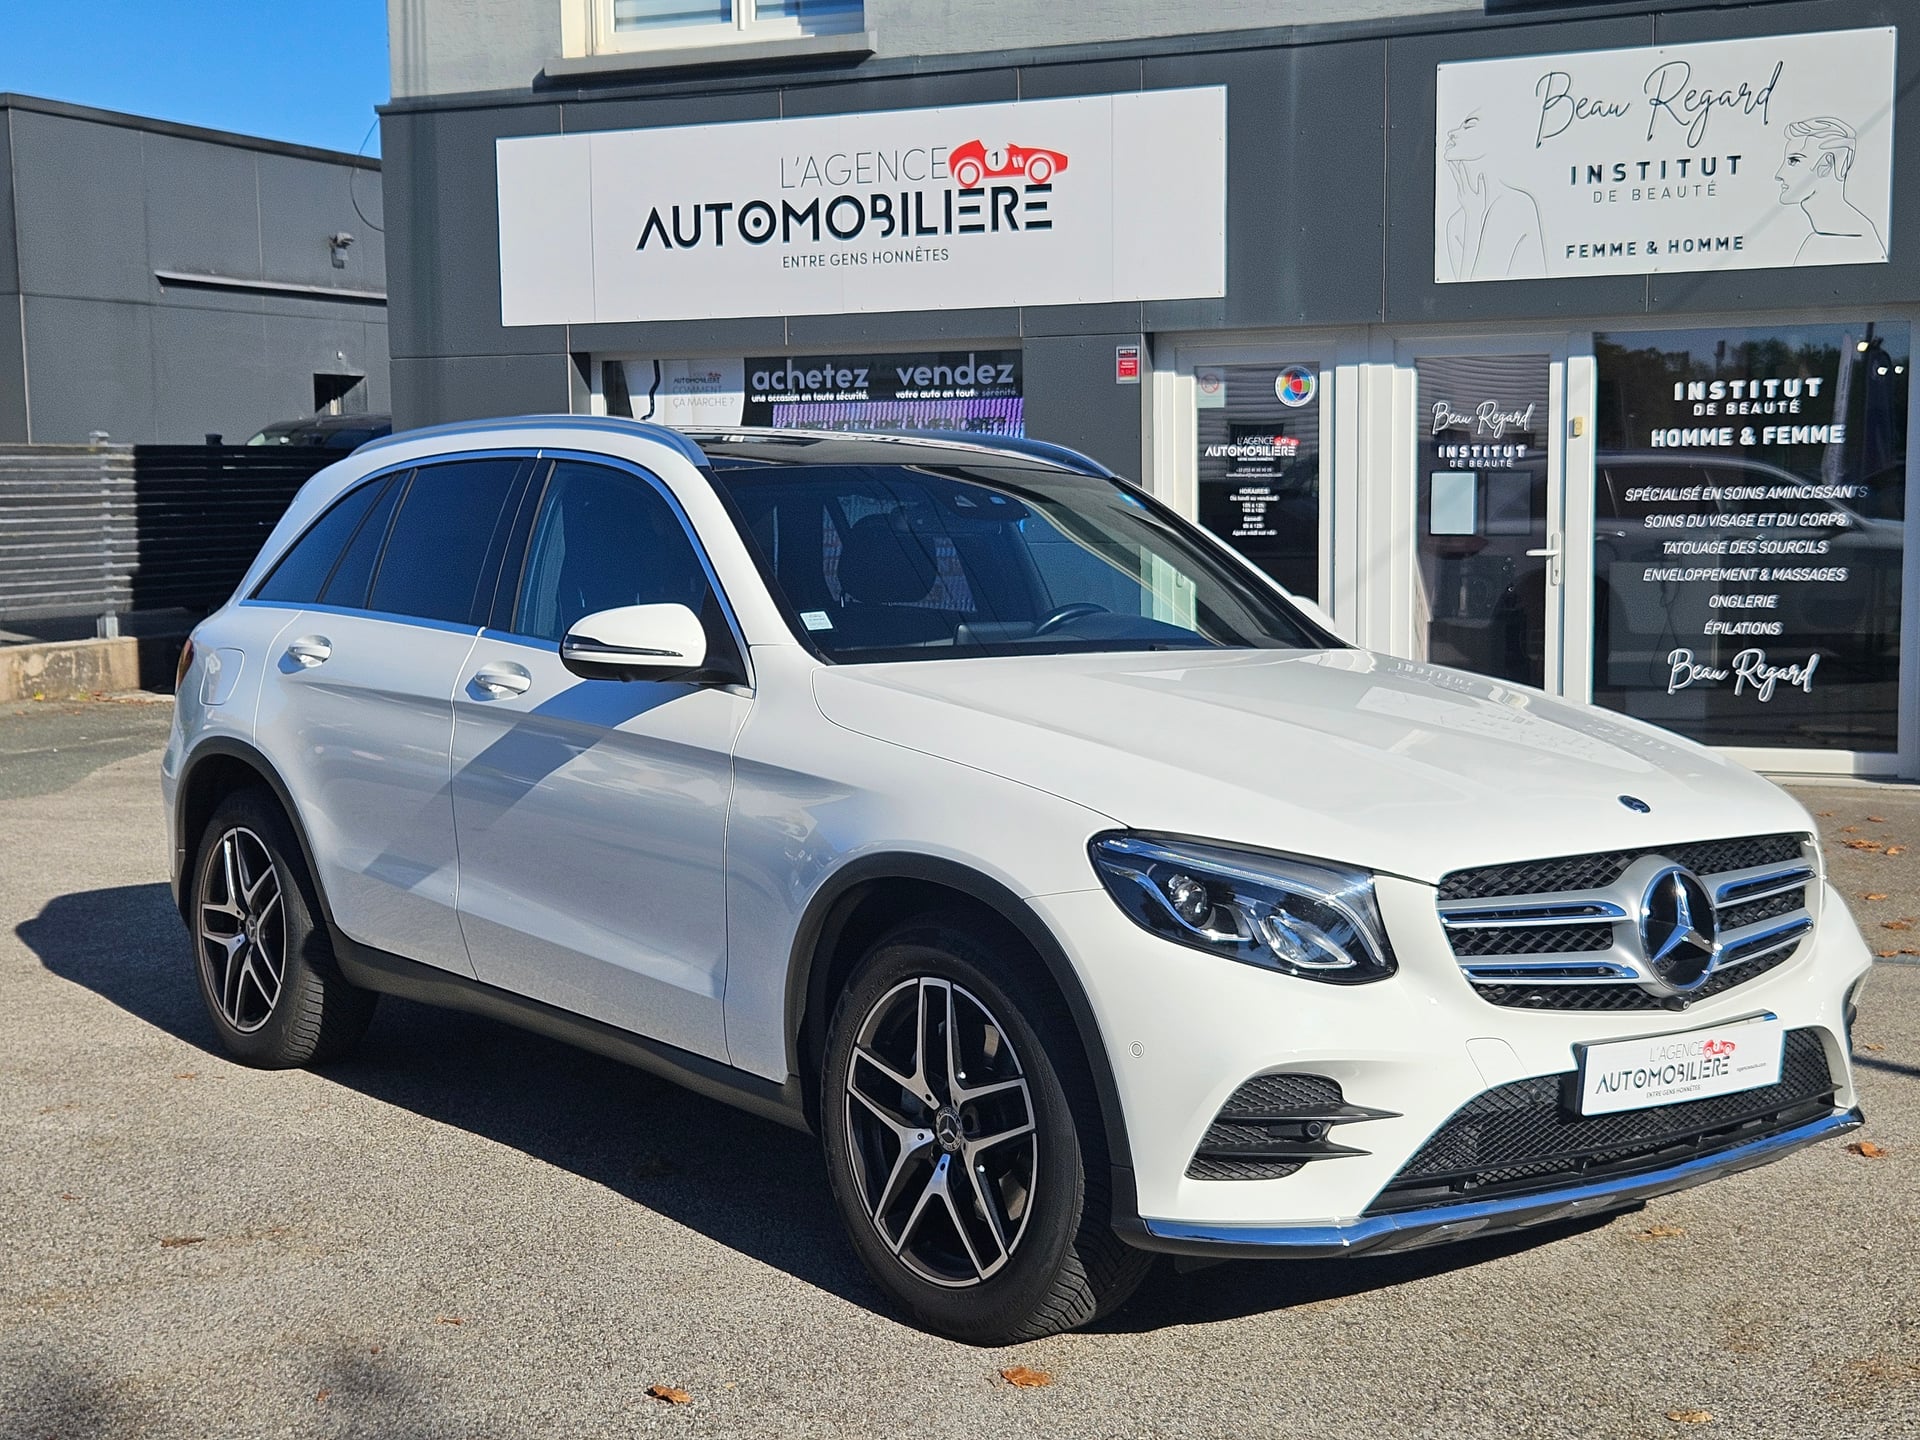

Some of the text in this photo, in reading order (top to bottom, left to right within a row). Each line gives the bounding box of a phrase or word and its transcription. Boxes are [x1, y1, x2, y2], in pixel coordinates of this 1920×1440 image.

[1535, 60, 1784, 148] Beau Regard
[781, 146, 948, 189] L'AGENCE
[1571, 155, 1742, 185] INSTITUT
[1593, 181, 1717, 204] DE BEAUTÉ
[1566, 235, 1744, 259] FEMME & HOMME
[783, 246, 949, 269] ENTRE GENS HONNÊTES
[751, 353, 1015, 390] achetez vendez
[751, 389, 869, 403] une occasion en toute sécurité.
[895, 388, 919, 399] votre
[920, 388, 941, 399] auto
[942, 389, 954, 398] en
[1674, 377, 1824, 401] INSTITUT
[688, 397, 727, 407] MARCHE
[1693, 399, 1801, 417] DE BEAUTÉ
[1431, 401, 1536, 439] Beau Regard
[1651, 424, 1846, 448] HOMME & FEMME
[1438, 444, 1527, 458] INSTITUT
[1449, 458, 1515, 468] DE BEAUTÉ
[1625, 484, 1868, 501] SPÉCIALISÉ EN SOINS AMINCISSANTS
[1644, 514, 1684, 528] SOINS
[1686, 514, 1706, 528] DU
[1708, 513, 1754, 527] VISAGE
[1757, 513, 1776, 527] ET
[1776, 513, 1798, 527] DU
[1662, 540, 1831, 554] TATOUAGE DES SOURCILS
[1643, 567, 1849, 582] ENVELOPPEMENT & MASSAGES
[1709, 593, 1779, 609] ONGLERIE
[1703, 619, 1784, 635] ÉPILATIONS
[1667, 647, 1821, 702] Beau Regard
[1650, 1040, 1704, 1062] L'AGENCE
